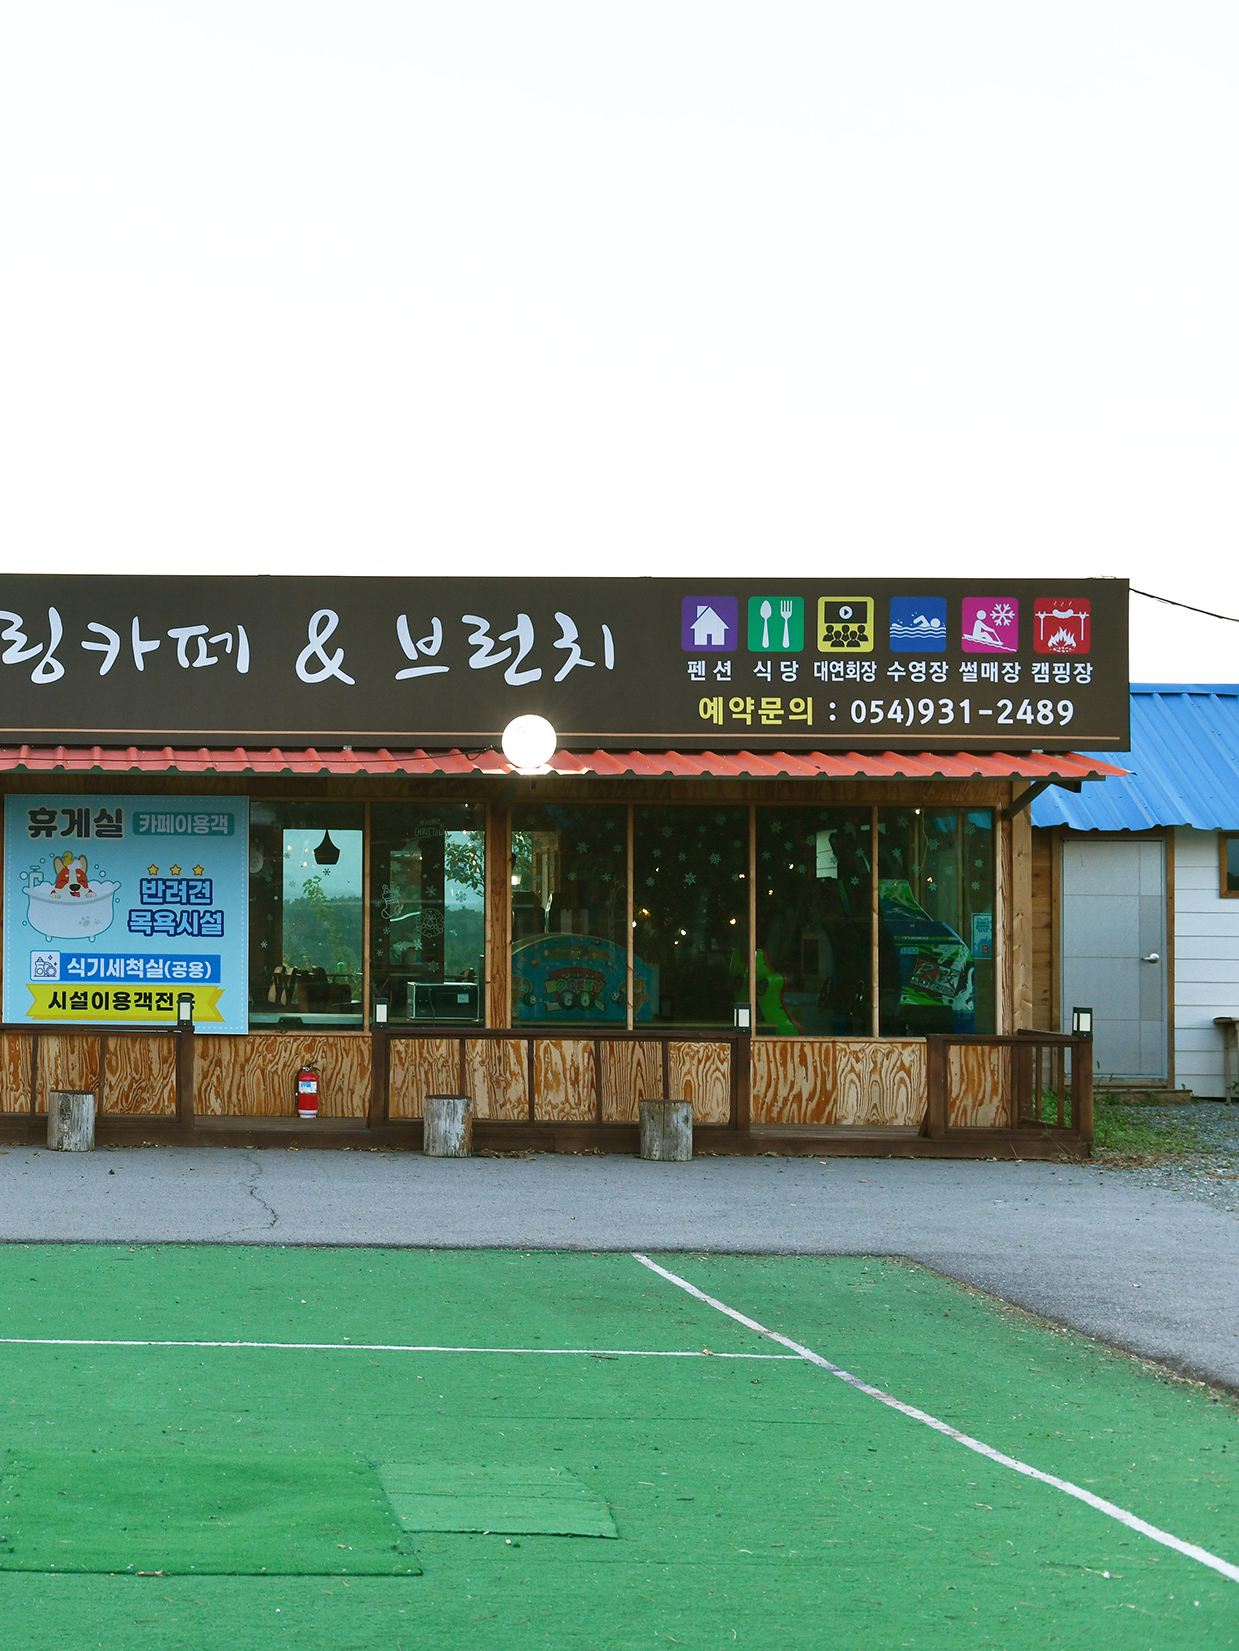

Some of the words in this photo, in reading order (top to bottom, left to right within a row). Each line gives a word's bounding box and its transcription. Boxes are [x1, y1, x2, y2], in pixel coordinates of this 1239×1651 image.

[295, 609, 356, 685] &
[395, 611, 615, 686] 브런치
[813, 660, 878, 683] 대연회장
[886, 661, 949, 683] 수영장
[958, 661, 1022, 684] 썰매장
[1031, 662, 1094, 685] 캠핑장
[698, 697, 814, 726] 예약문의
[850, 697, 1075, 727] 054)931-2489
[27, 807, 124, 838] 휴게실
[139, 814, 229, 835] 카페이용객
[140, 878, 214, 905] 반려견
[128, 909, 225, 937] 목욕시설
[66, 957, 213, 979] 식기세척실(공용)
